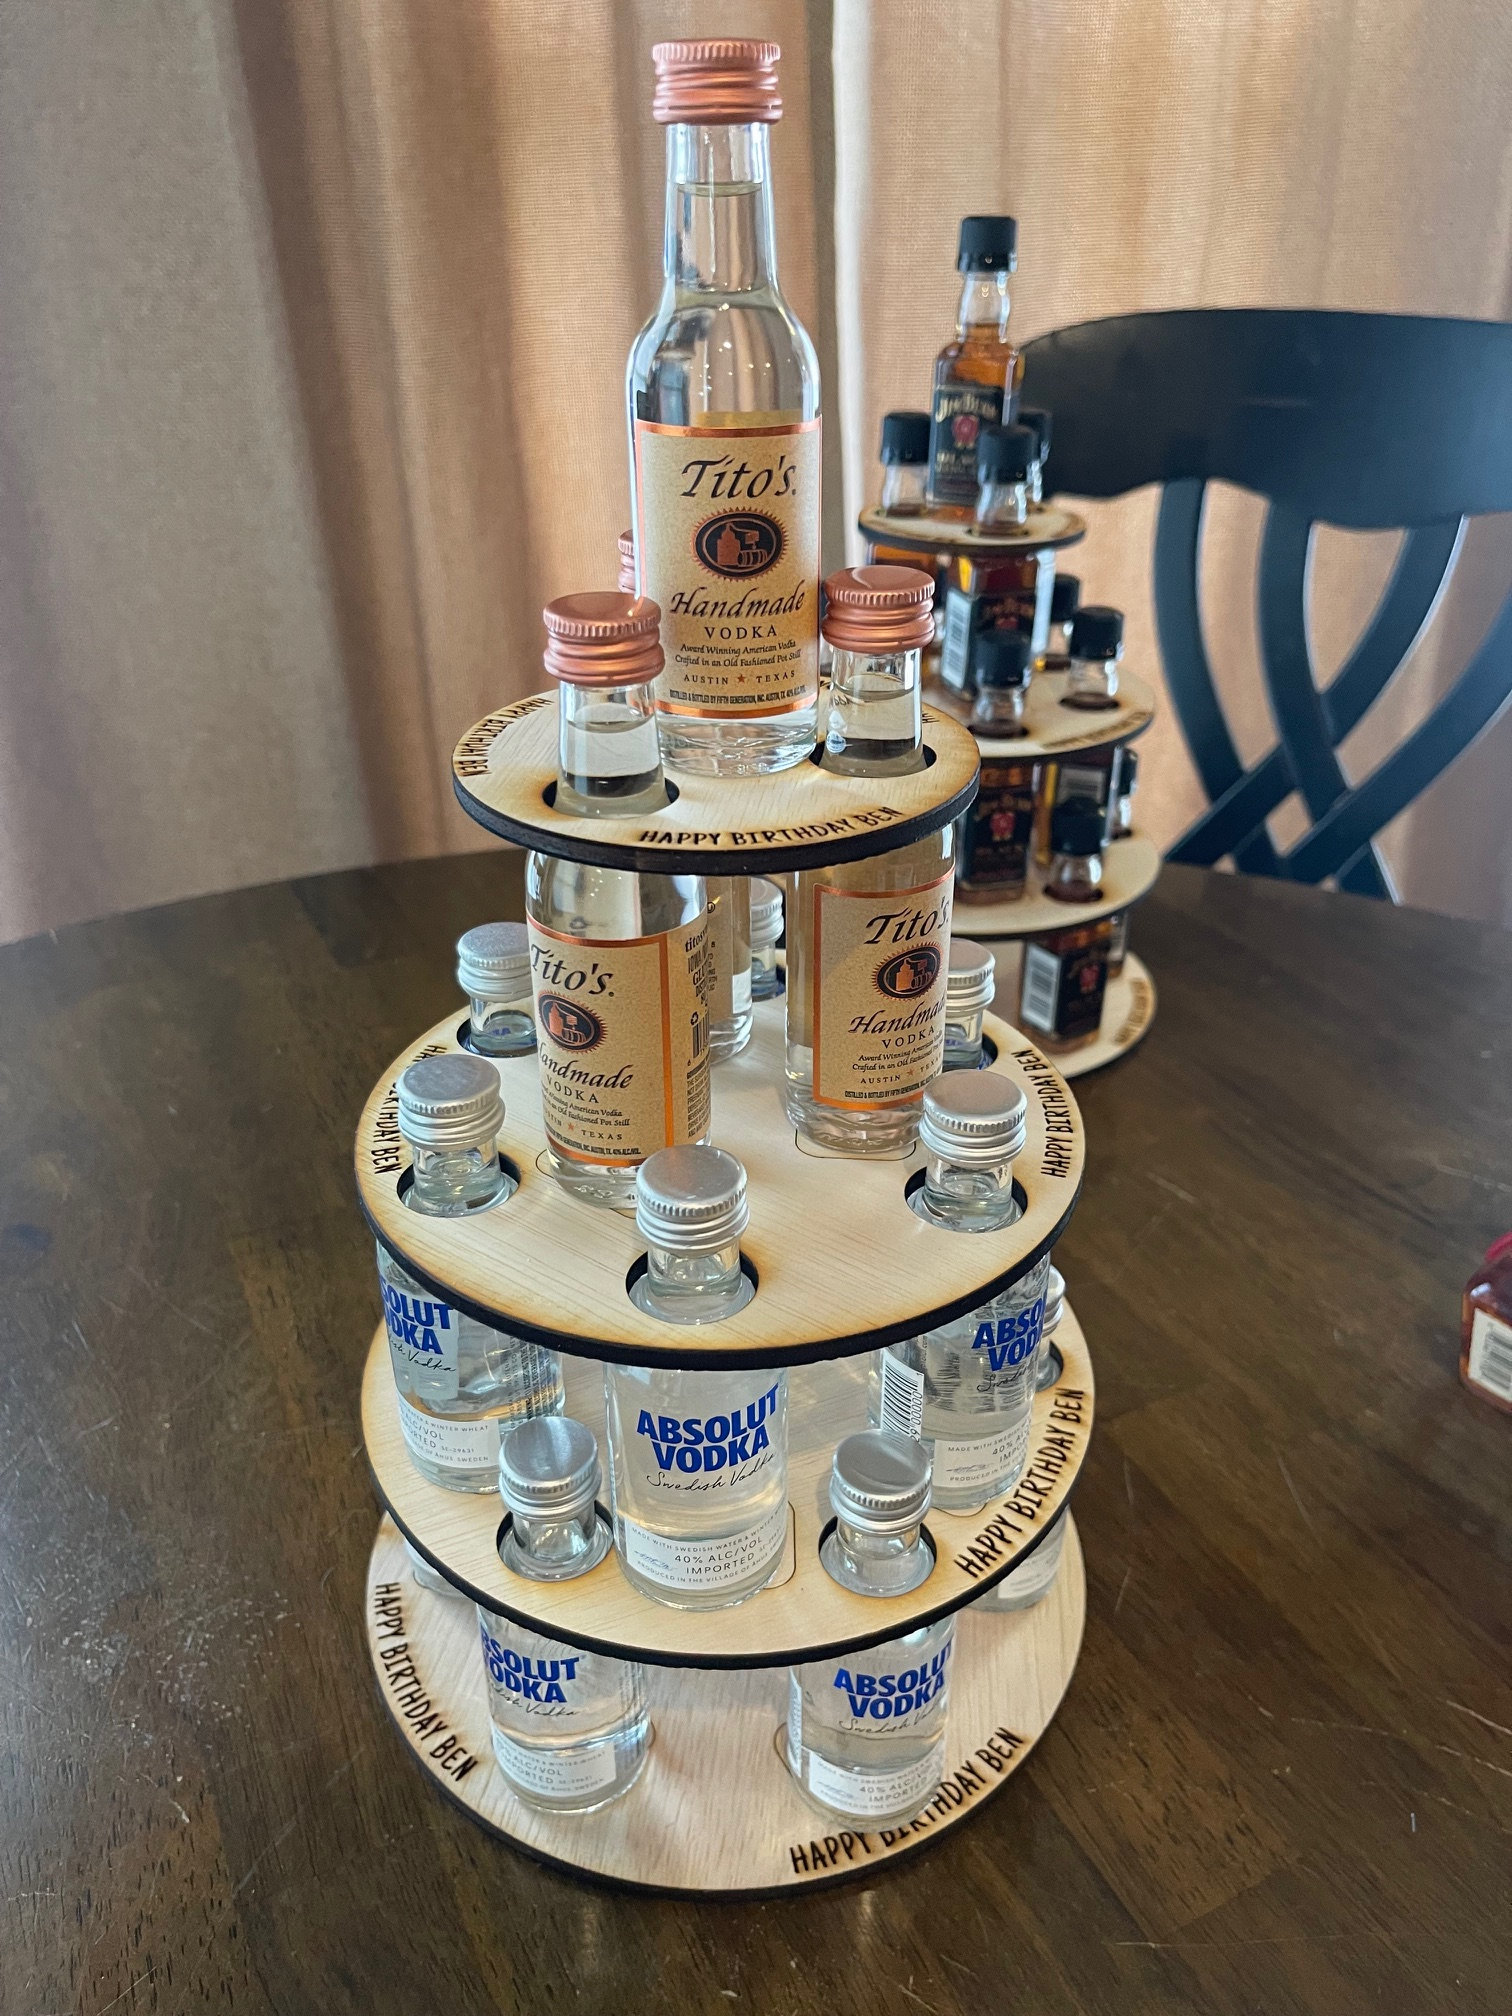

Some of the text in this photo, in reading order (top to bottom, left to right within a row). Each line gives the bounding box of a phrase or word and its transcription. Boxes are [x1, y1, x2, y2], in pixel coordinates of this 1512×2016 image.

[670, 580, 805, 619] Handmade
[704, 624, 777, 640] VODKA
[680, 639, 797, 657] Award Winning American Vodka
[675, 654, 700, 667] Crafted
[702, 657, 710, 666] in
[723, 656, 738, 667] Old
[740, 655, 775, 667] Fashioned
[777, 653, 788, 663] Pot
[684, 670, 796, 685] AUSTIN TEXAS
[460, 718, 515, 757] BIRTHDAY
[457, 759, 493, 777] BEN
[639, 806, 903, 846] HAPPY BIRTHDAY BEN
[882, 1025, 935, 1049] VODKA
[852, 1063, 876, 1072] Crafted
[858, 1054, 882, 1062] Award
[860, 1075, 901, 1084] AUSTIN
[600, 1109, 622, 1117] Vodka
[1011, 1049, 1074, 1178] HAPPY BIRTHDAY BEN
[581, 1129, 623, 1141] TEXAS
[371, 1146, 403, 1174] BEN
[971, 1290, 1047, 1349] ABSO
[408, 1350, 456, 1372] Vodka
[637, 1382, 780, 1446] ABSOLUT
[652, 1424, 770, 1474] VODKA
[973, 1441, 992, 1451] WITH
[646, 1451, 777, 1492] Swedish Vodka
[949, 1471, 990, 1482] PRODUCED
[954, 1514, 1023, 1579] HAPPY
[1012, 1423, 1079, 1520] BIRTHDAY
[1049, 1387, 1085, 1424] BEN
[631, 1527, 651, 1541] MADE
[653, 1539, 673, 1550] WITH
[715, 1538, 743, 1551] WATER
[675, 1554, 703, 1564] 40%
[708, 1536, 763, 1563] ALC/VOL
[636, 1560, 675, 1581] PRODUCED
[706, 1571, 739, 1583] VILLAGE
[686, 1552, 755, 1575] IMPORTED
[375, 1582, 479, 1783] HAPPY BIRTHDAY BEN
[488, 1656, 568, 1703] ODKA
[848, 1670, 945, 1720] VODKA
[525, 1702, 579, 1717] Vodka
[839, 1718, 911, 1734] Swedish
[789, 1831, 872, 1874] HAPPY
[879, 1759, 987, 1848] BIRTHDAY
[975, 1726, 1025, 1773] BEN
[859, 1785, 886, 1794] 40%
